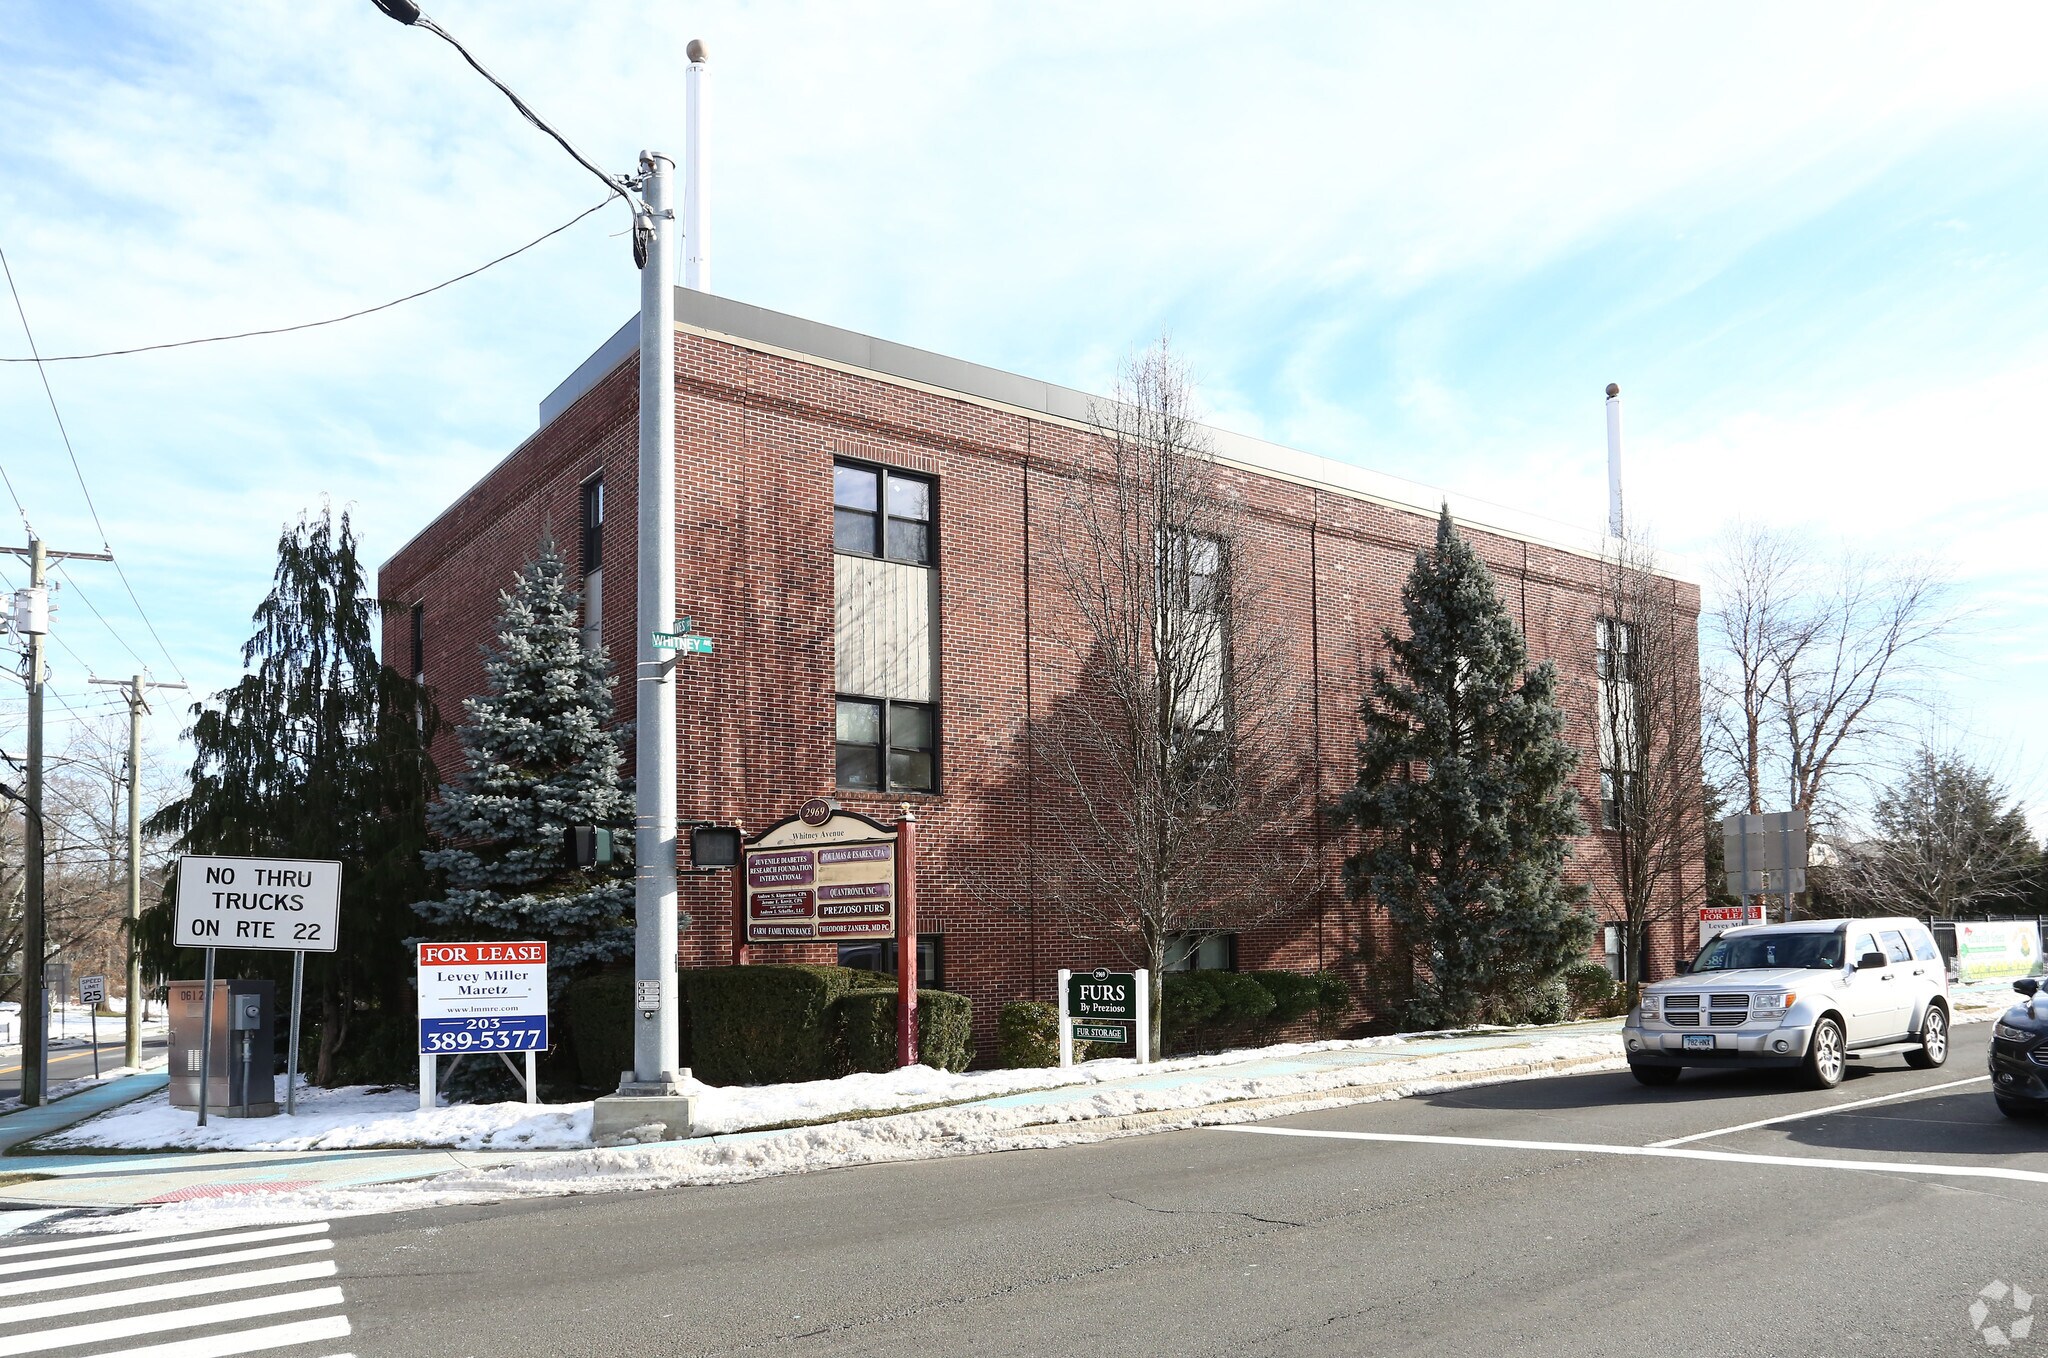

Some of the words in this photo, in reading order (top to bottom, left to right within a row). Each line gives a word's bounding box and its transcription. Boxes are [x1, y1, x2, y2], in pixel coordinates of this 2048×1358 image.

[653, 634, 700, 650] WHITNEY
[804, 806, 825, 818] 2969
[792, 832, 819, 840] Whitney
[874, 849, 885, 857] CPA
[755, 858, 780, 866] JUVENILE
[781, 856, 807, 864] DIABETES
[750, 866, 777, 874] RESEARCH
[778, 864, 812, 872] FOUNDATION
[206, 867, 235, 885] NO
[255, 869, 312, 888] THRU
[760, 873, 802, 882] INTERNATIONAL
[866, 887, 877, 895] INC.
[212, 892, 304, 911] TRUCKS
[824, 905, 862, 915] PREZIOSO
[864, 904, 885, 913] FURS
[192, 919, 220, 936] ON
[236, 920, 275, 938] RTE
[294, 923, 321, 940] 22
[819, 924, 847, 933] THEODORE
[848, 924, 871, 932] ZANKER,
[426, 947, 469, 962] FOR
[477, 946, 542, 961] LEASE
[437, 971, 480, 983] Levey
[485, 970, 528, 981] Miller
[84, 990, 102, 1002] 25
[458, 985, 508, 995] Maretz
[1080, 985, 1125, 1001] FURS
[1080, 1002, 1090, 1014] By
[1093, 1003, 1125, 1012] Prezioso
[466, 1018, 500, 1030] 203
[1077, 1028, 1090, 1036] FUR
[1091, 1028, 1121, 1037] STORAGE
[427, 1030, 541, 1050] 389-5377
